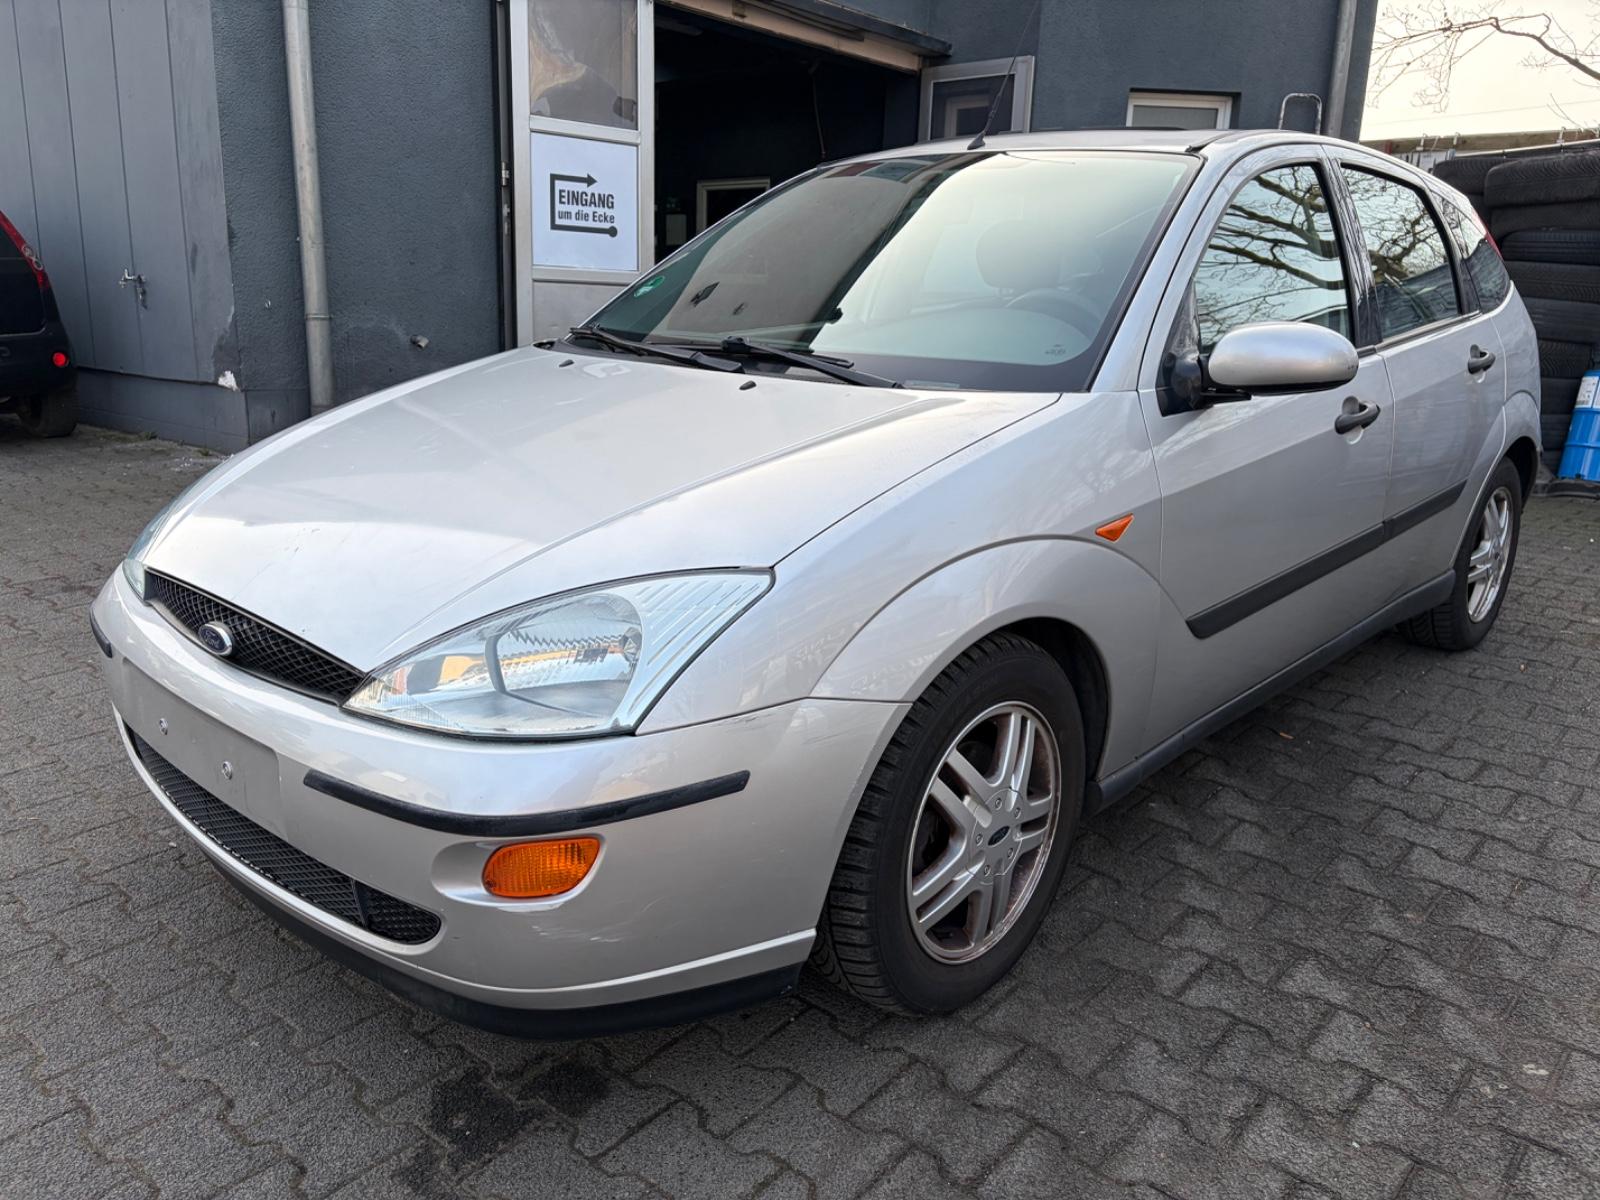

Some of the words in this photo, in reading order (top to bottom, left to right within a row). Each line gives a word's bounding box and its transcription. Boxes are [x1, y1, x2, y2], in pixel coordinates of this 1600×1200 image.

[559, 189, 615, 210] EINGANG
[558, 210, 572, 220] um
[575, 209, 589, 222] die
[592, 211, 615, 224] Ecke
